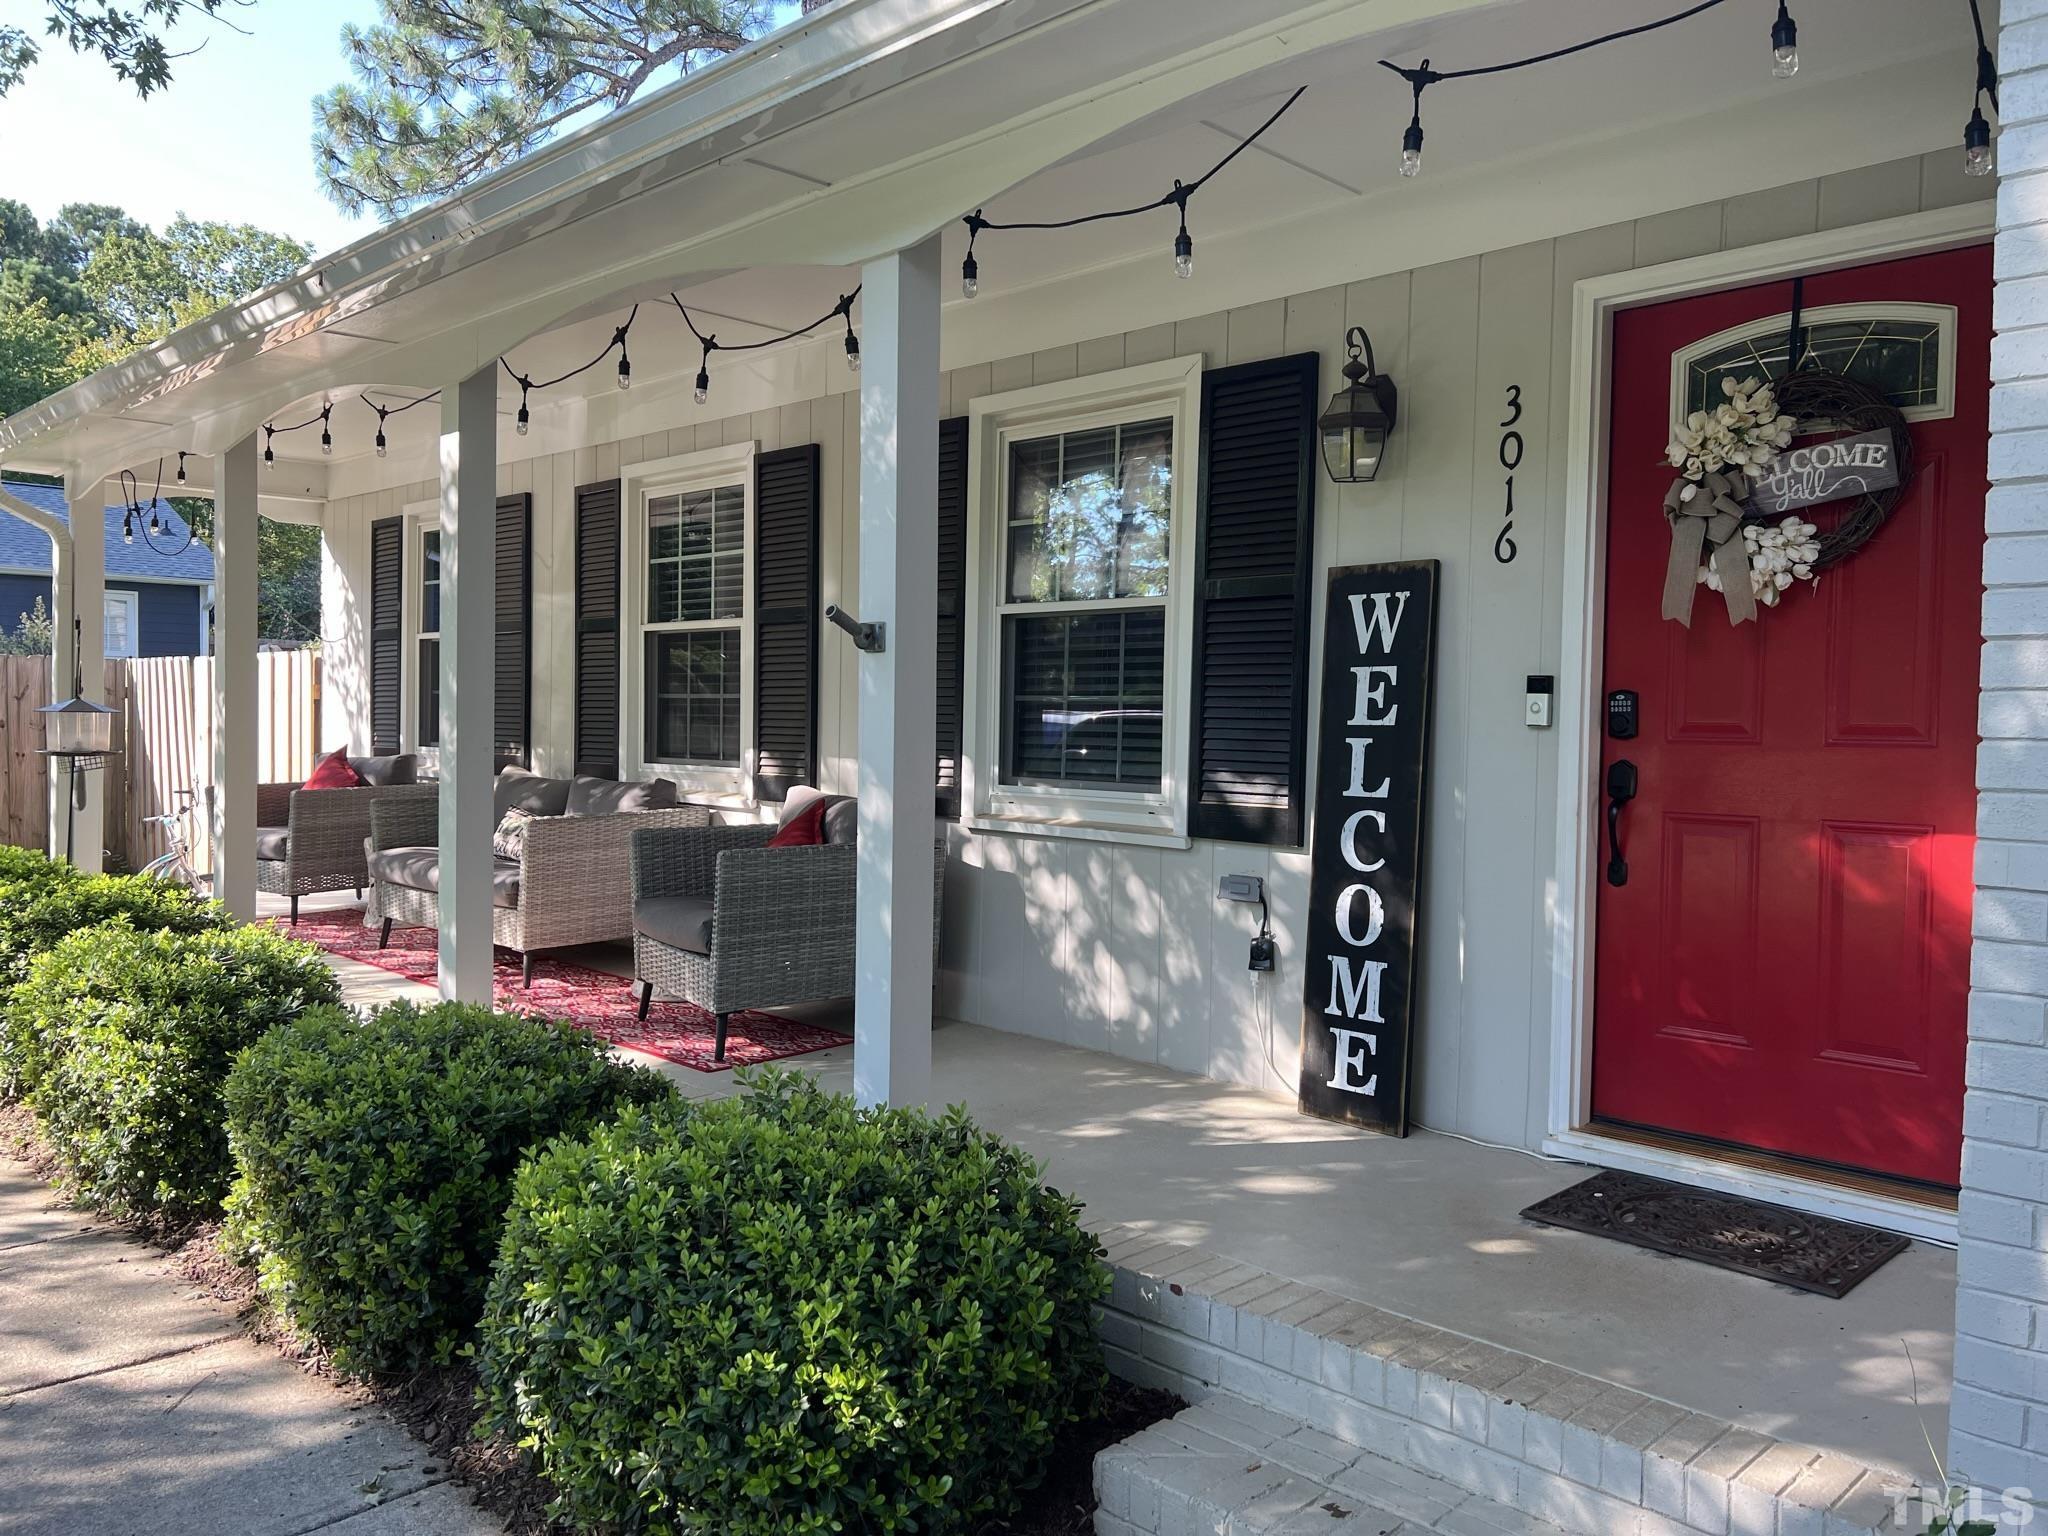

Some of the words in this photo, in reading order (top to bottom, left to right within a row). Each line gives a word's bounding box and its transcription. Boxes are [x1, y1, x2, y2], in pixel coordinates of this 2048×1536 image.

[1495, 384, 1524, 564] 3016
[1755, 443, 1888, 488] ELCOME
[1324, 590, 1411, 1097] WELCOME
